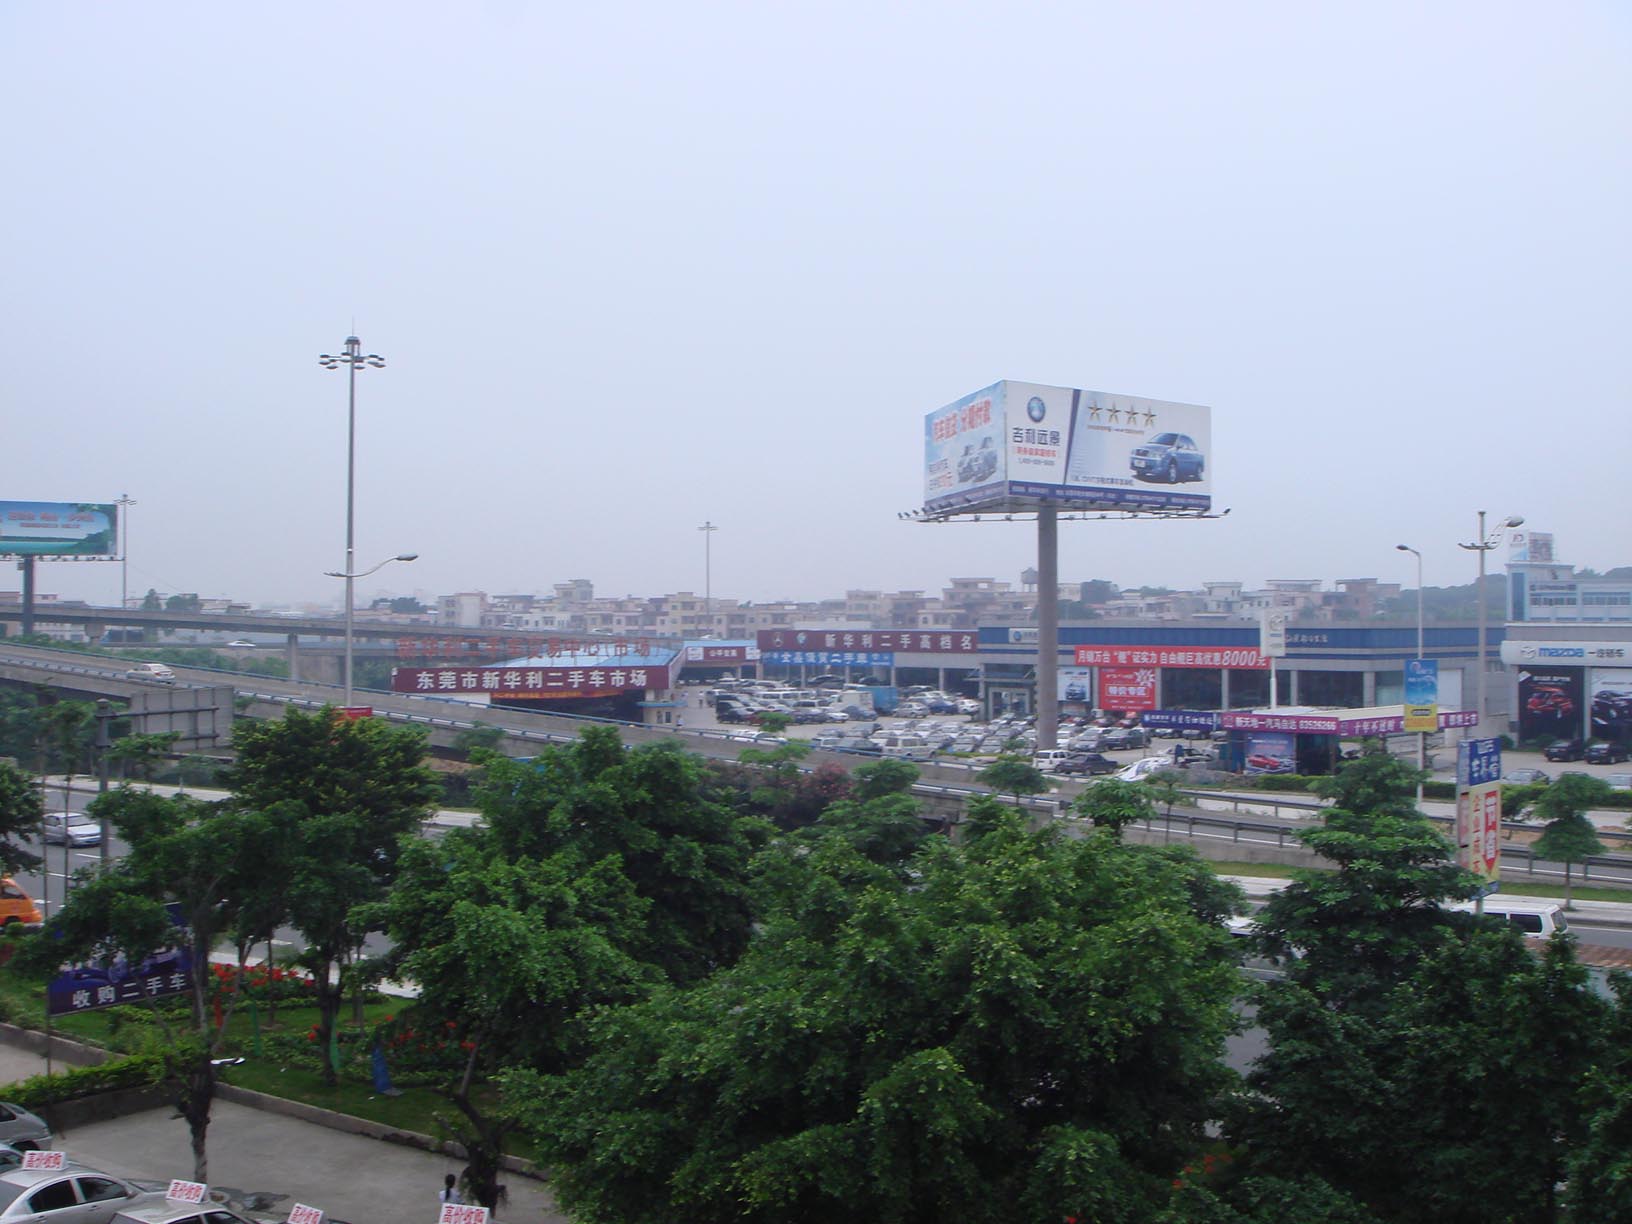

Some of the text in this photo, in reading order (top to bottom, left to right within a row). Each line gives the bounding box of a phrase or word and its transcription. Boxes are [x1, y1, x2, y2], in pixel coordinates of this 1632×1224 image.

[1012, 427, 1060, 446] 吉利远景
[416, 669, 647, 689] 东莞市新华利二手车市场
[72, 972, 187, 1009] 收购二手车
[26, 1152, 63, 1170] 高价收购
